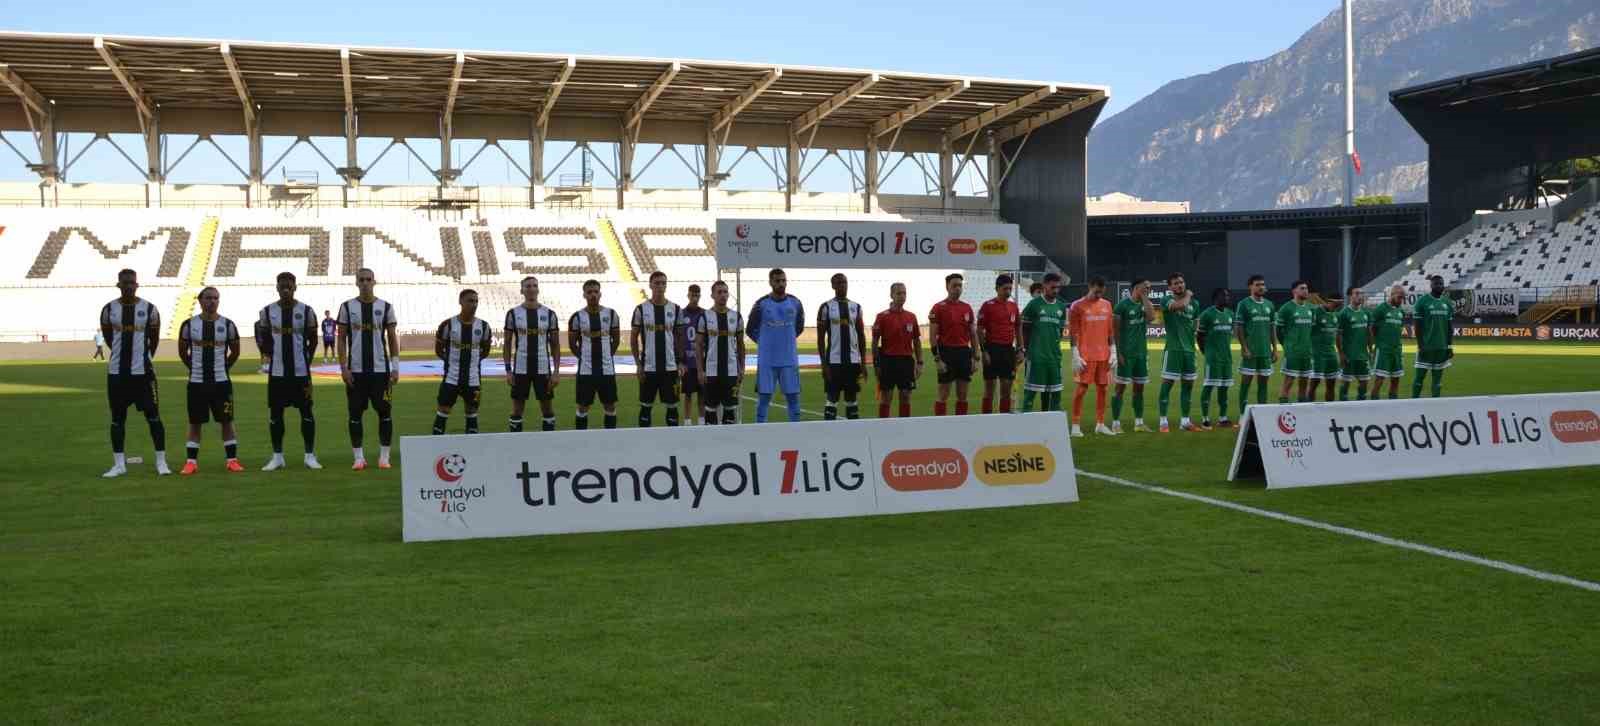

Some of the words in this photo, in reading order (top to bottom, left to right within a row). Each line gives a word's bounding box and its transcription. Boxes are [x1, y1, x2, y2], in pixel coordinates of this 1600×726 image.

[772, 230, 884, 259] trendyol
[1553, 328, 1599, 340] BURÇAK
[1271, 435, 1312, 448] trendyol
[1328, 412, 1481, 455] trendyol
[890, 460, 961, 477] trendyol
[984, 452, 1046, 474] NESİNE
[516, 452, 761, 509] trendyol
[419, 484, 486, 501] trendyol
